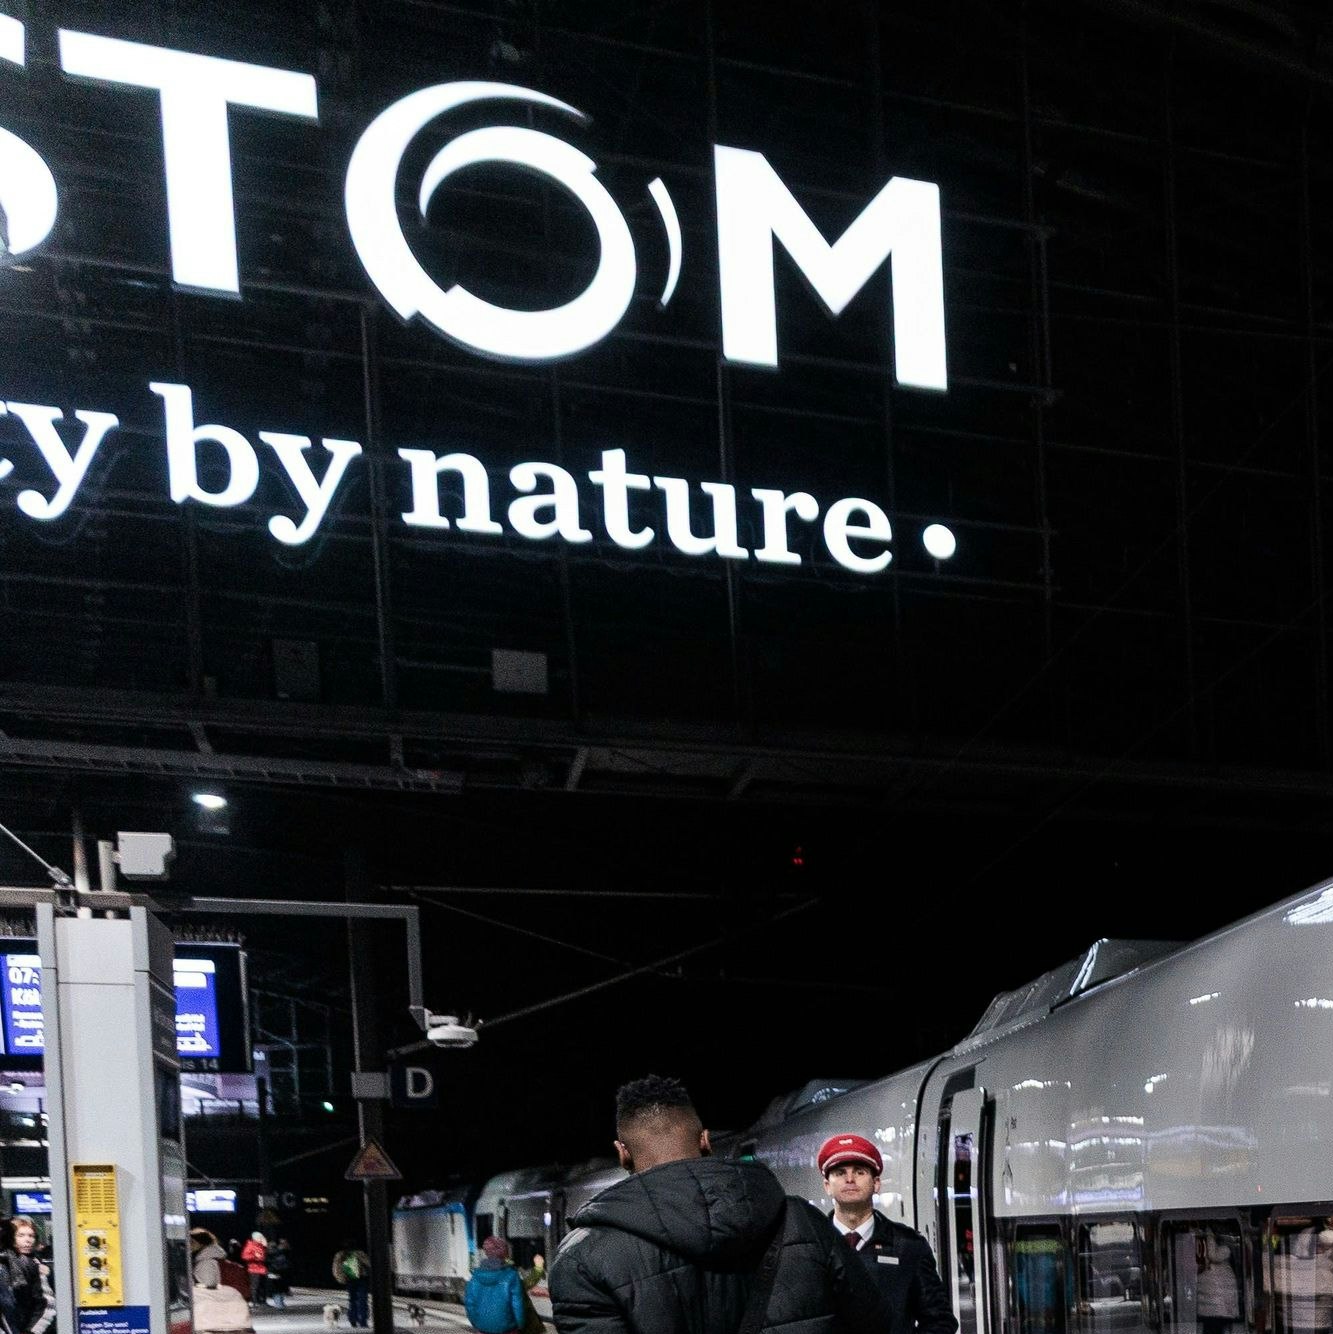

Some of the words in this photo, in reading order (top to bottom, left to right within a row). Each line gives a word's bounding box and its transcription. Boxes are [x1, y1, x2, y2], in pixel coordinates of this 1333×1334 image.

[0, 14, 950, 392] TOM
[0, 400, 120, 522] y
[149, 382, 362, 545] by
[407, 1068, 432, 1097] D
